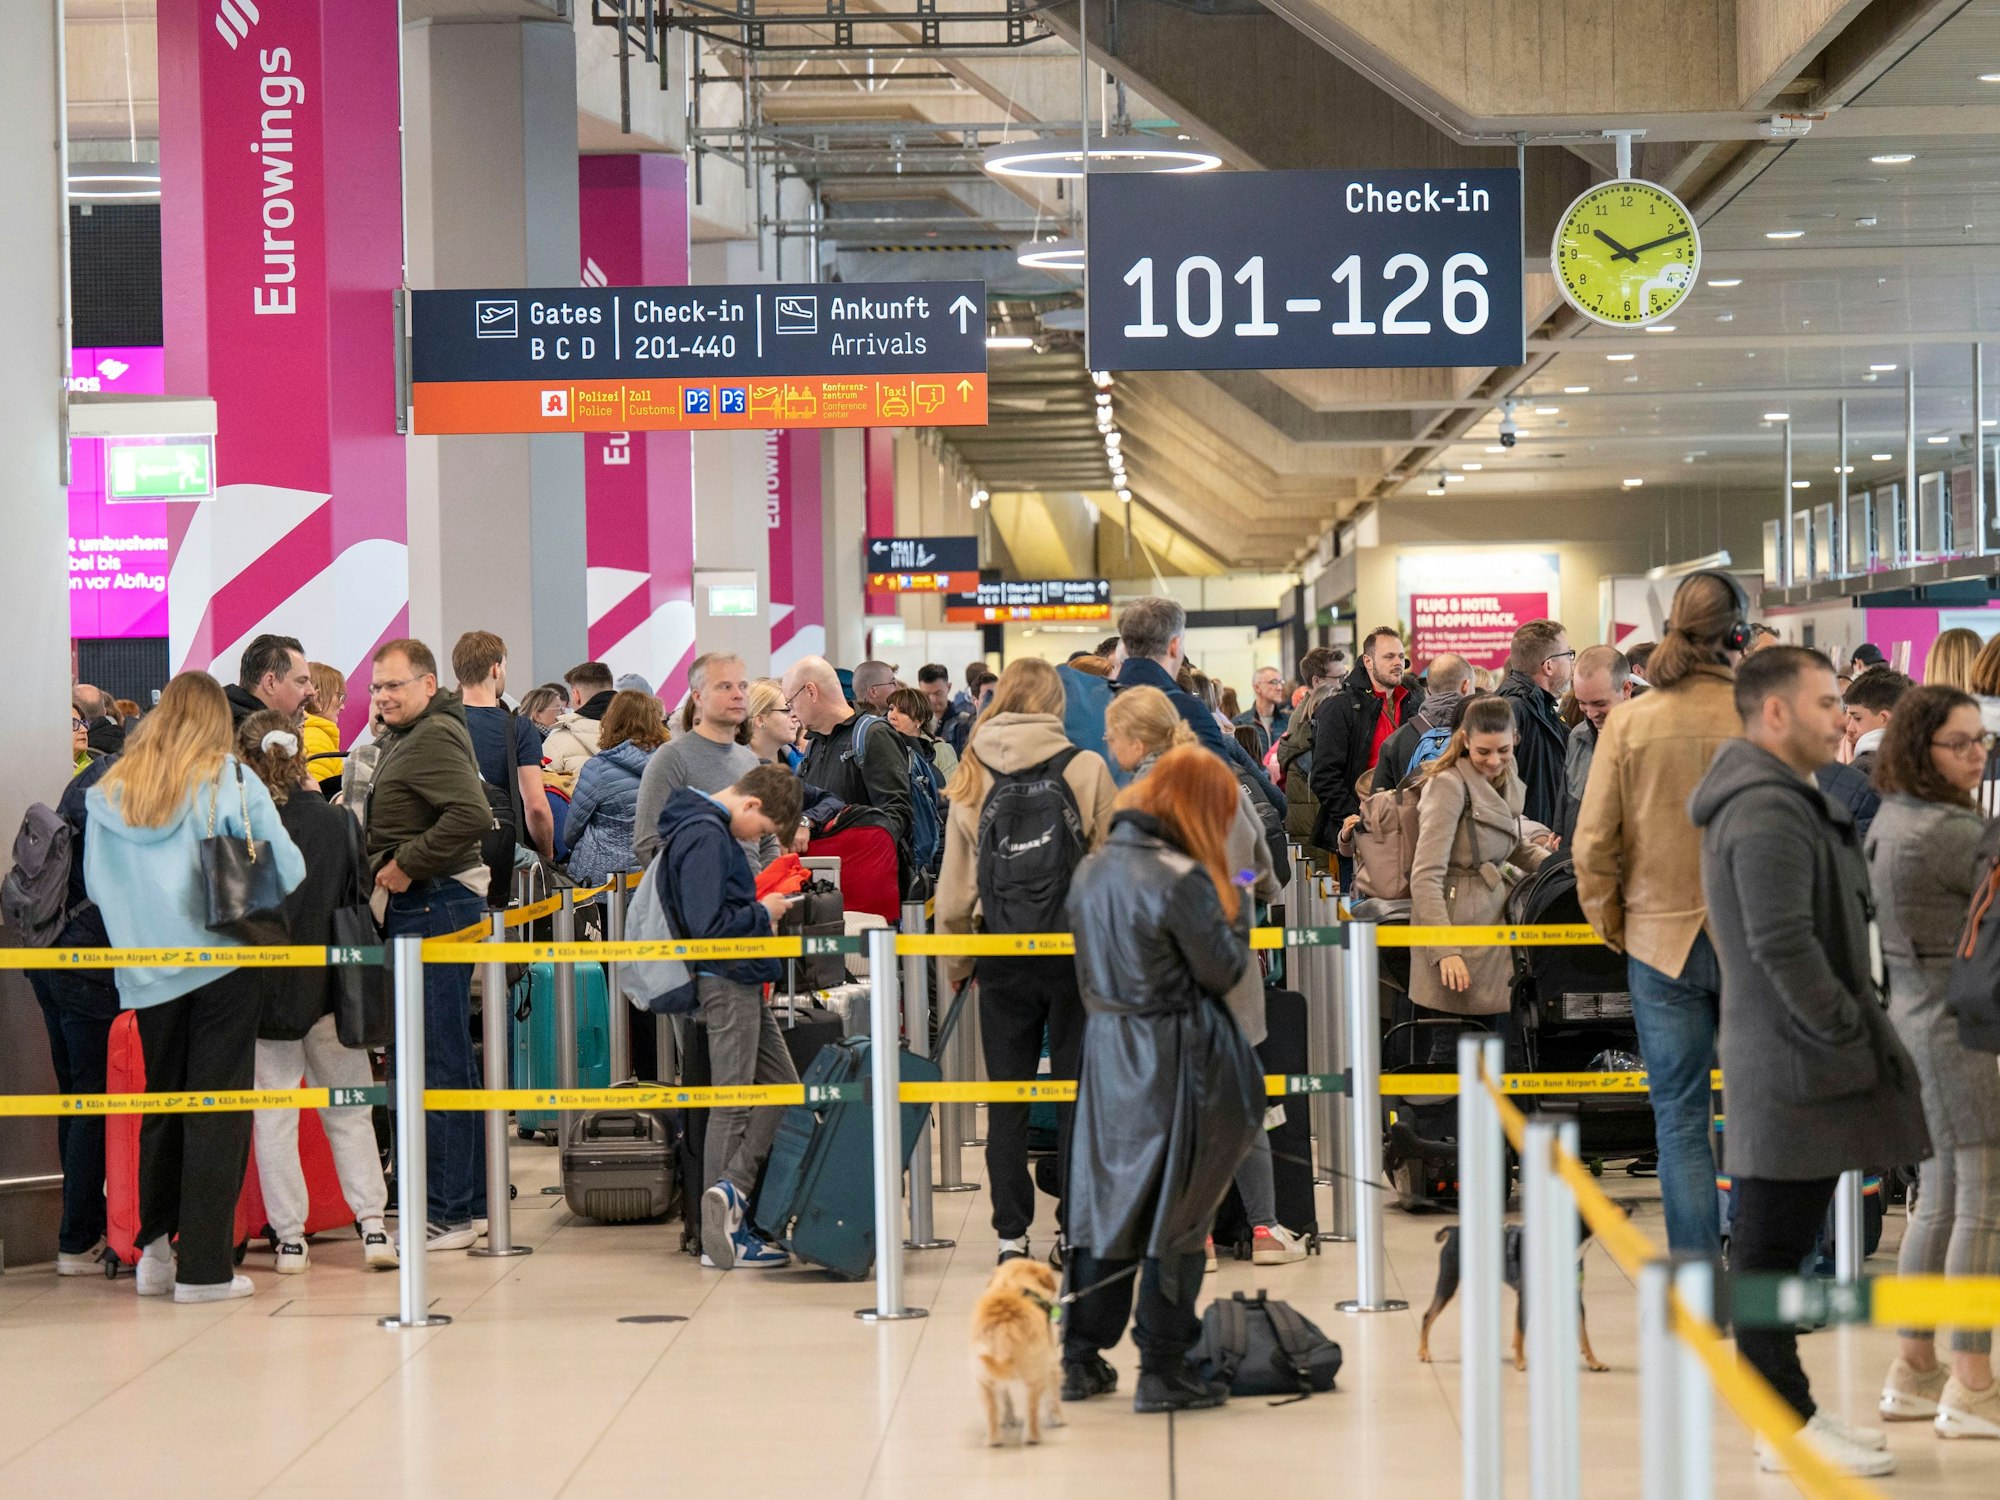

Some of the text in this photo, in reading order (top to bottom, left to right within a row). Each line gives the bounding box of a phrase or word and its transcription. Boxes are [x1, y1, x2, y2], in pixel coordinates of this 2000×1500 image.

[254, 47, 305, 315] Eurowings
[1345, 182, 1490, 213] Check-in
[1620, 196, 1633, 207] 12
[1595, 205, 1608, 215] 11
[1650, 205, 1656, 215] 1
[1576, 224, 1590, 234] 10
[1667, 224, 1674, 235] 2
[1571, 249, 1578, 259] 9
[1676, 249, 1682, 259] 3
[1579, 274, 1586, 284] 8
[1123, 252, 1490, 338] 101-126
[1597, 295, 1603, 305] 7
[1651, 294, 1658, 305] 5
[634, 300, 744, 323] Check-in
[831, 296, 930, 320] Ankunft
[1624, 301, 1631, 312] 6
[530, 302, 602, 325] Gates
[531, 336, 596, 361] B C D
[635, 335, 736, 359] 201-440
[831, 332, 927, 356] Arrivals
[822, 382, 868, 391] Konferenz-
[883, 386, 907, 397] Taxi
[578, 391, 619, 402] Polizei
[629, 390, 652, 401] Zoll
[822, 392, 858, 400] zentrum
[579, 405, 613, 416] Police
[629, 404, 676, 415] Customs
[823, 402, 867, 411] Conference
[823, 411, 849, 419] center
[85, 576, 112, 590] vor
[113, 572, 166, 593] Abflug
[1416, 598, 1448, 613] FLUG
[1416, 612, 1519, 628] IM DOPPELPACK.
[83, 952, 157, 962] Köln Bonn Airport
[215, 952, 290, 962] Köln Bonn Airport
[86, 1098, 161, 1109] Köln Bonn Airport
[219, 1095, 293, 1105] Köln Bonn Airport
